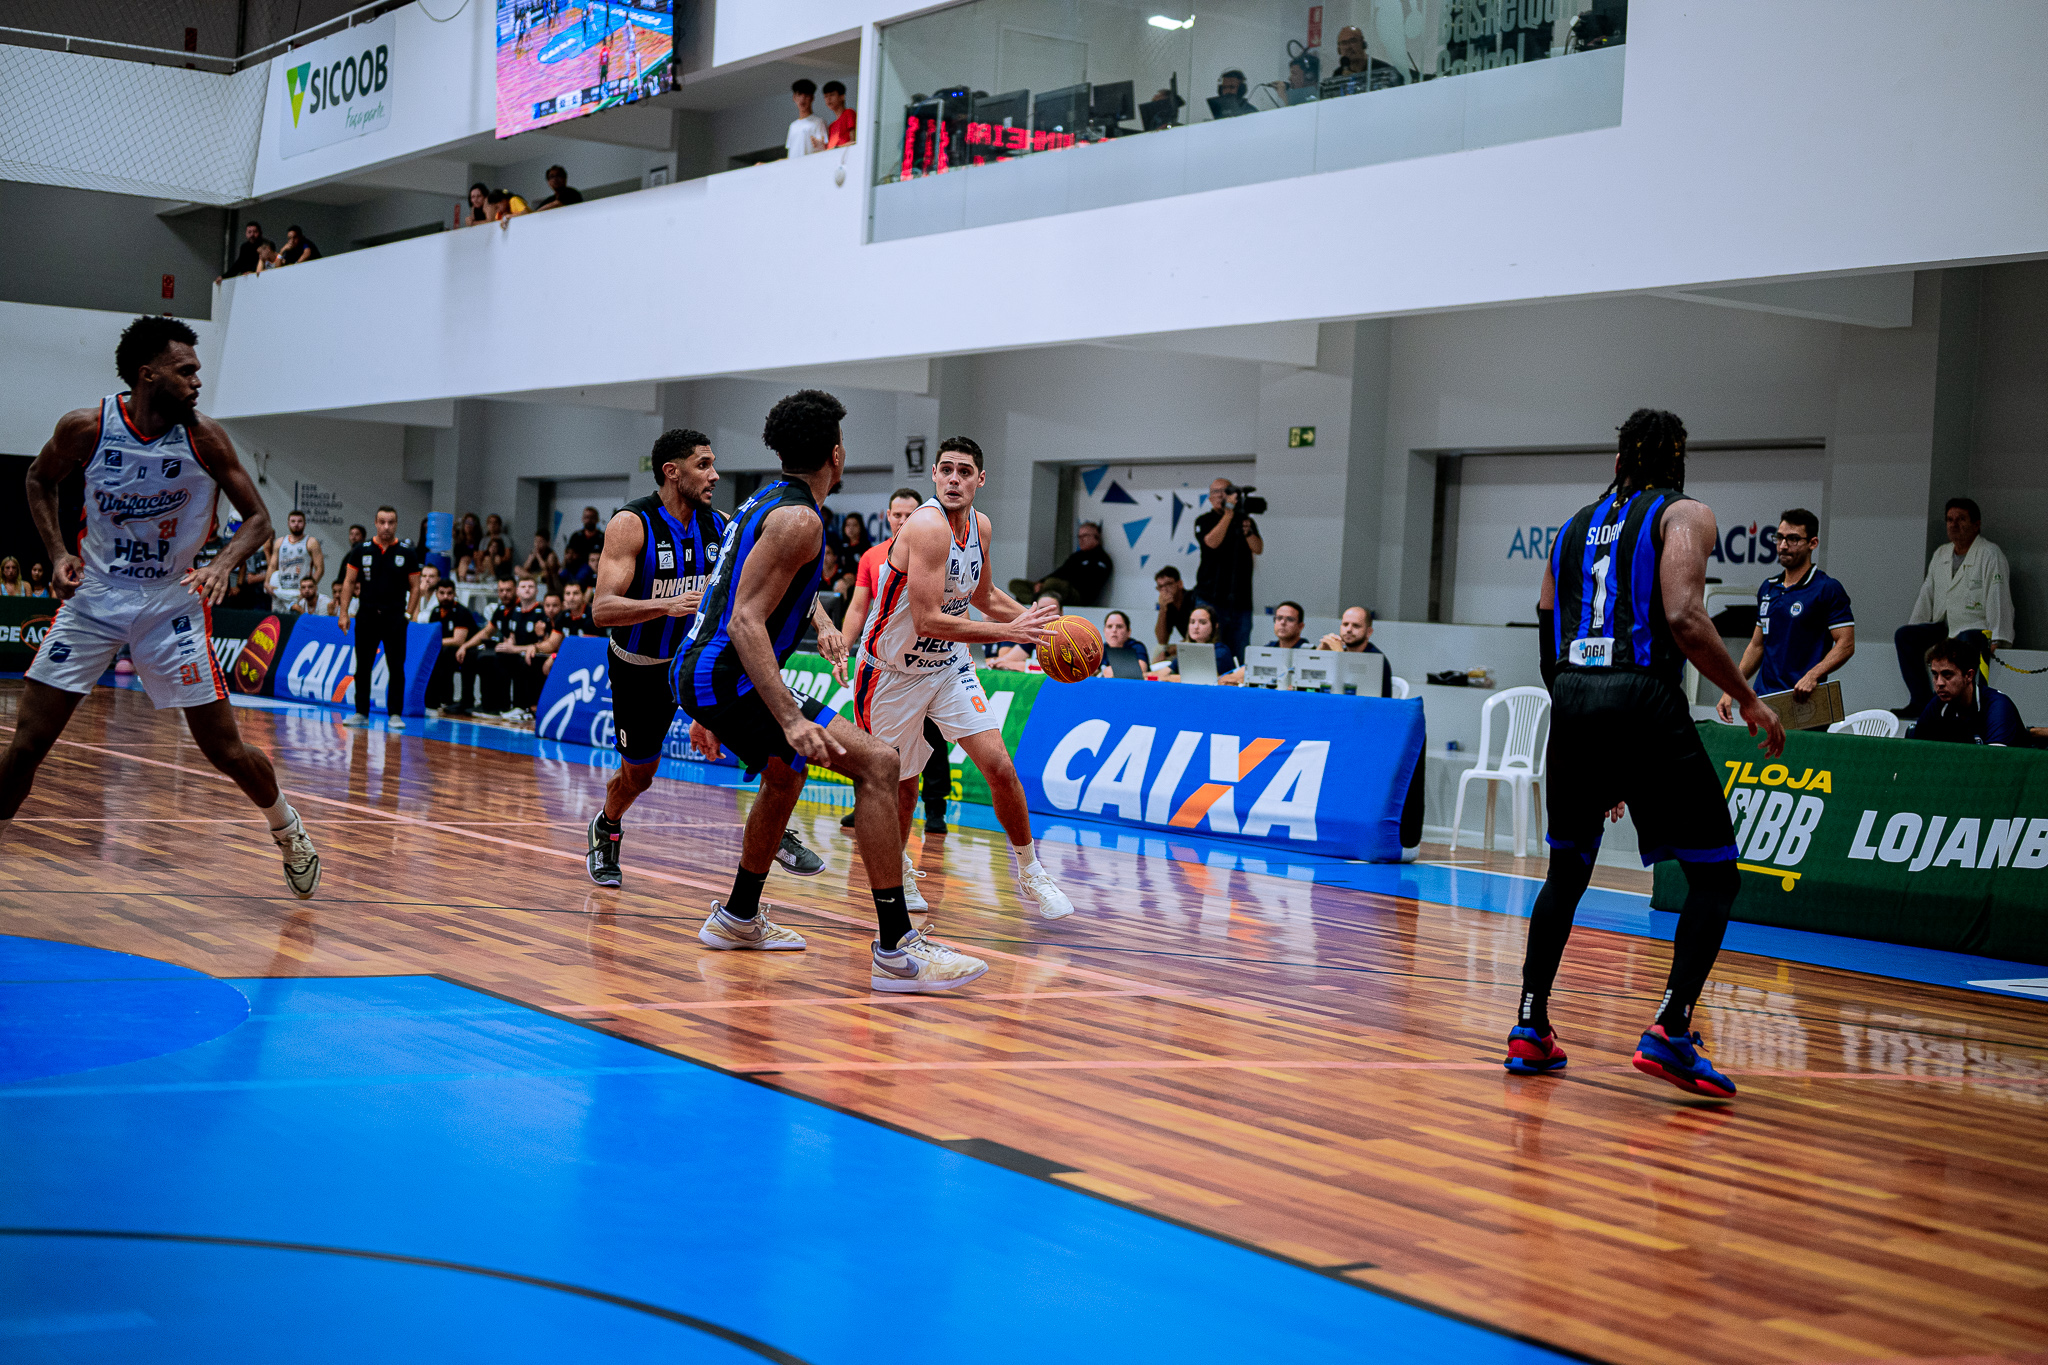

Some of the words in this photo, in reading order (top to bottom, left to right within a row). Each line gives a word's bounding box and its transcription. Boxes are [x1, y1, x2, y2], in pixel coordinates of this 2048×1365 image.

[309, 43, 389, 114] SICOOB
[95, 489, 188, 512] Unifacisa
[115, 538, 169, 563] HELP
[1591, 555, 1611, 629] 1
[180, 662, 202, 685] 21
[970, 695, 986, 713] 8
[620, 728, 627, 748] 9
[1042, 718, 1331, 842] CAIXA
[1738, 762, 1832, 793] LOJA
